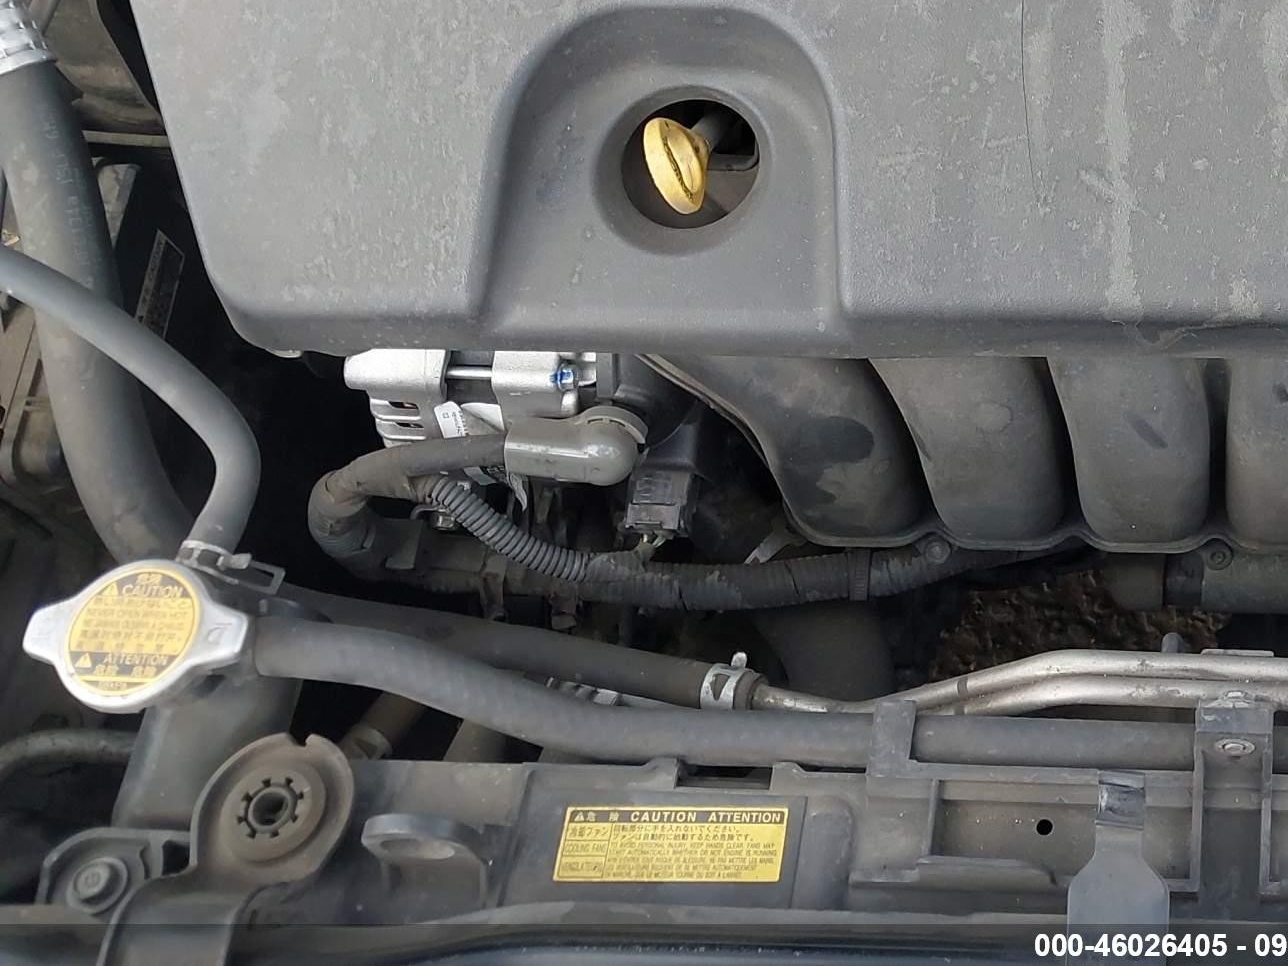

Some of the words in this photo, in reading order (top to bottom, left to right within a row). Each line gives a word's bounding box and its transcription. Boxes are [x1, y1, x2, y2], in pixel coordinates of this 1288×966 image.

[122, 584, 183, 599] CAUTION
[103, 652, 169, 666] ATTENTION
[630, 811, 697, 822] CAUTION
[708, 812, 781, 822] ATTENTION
